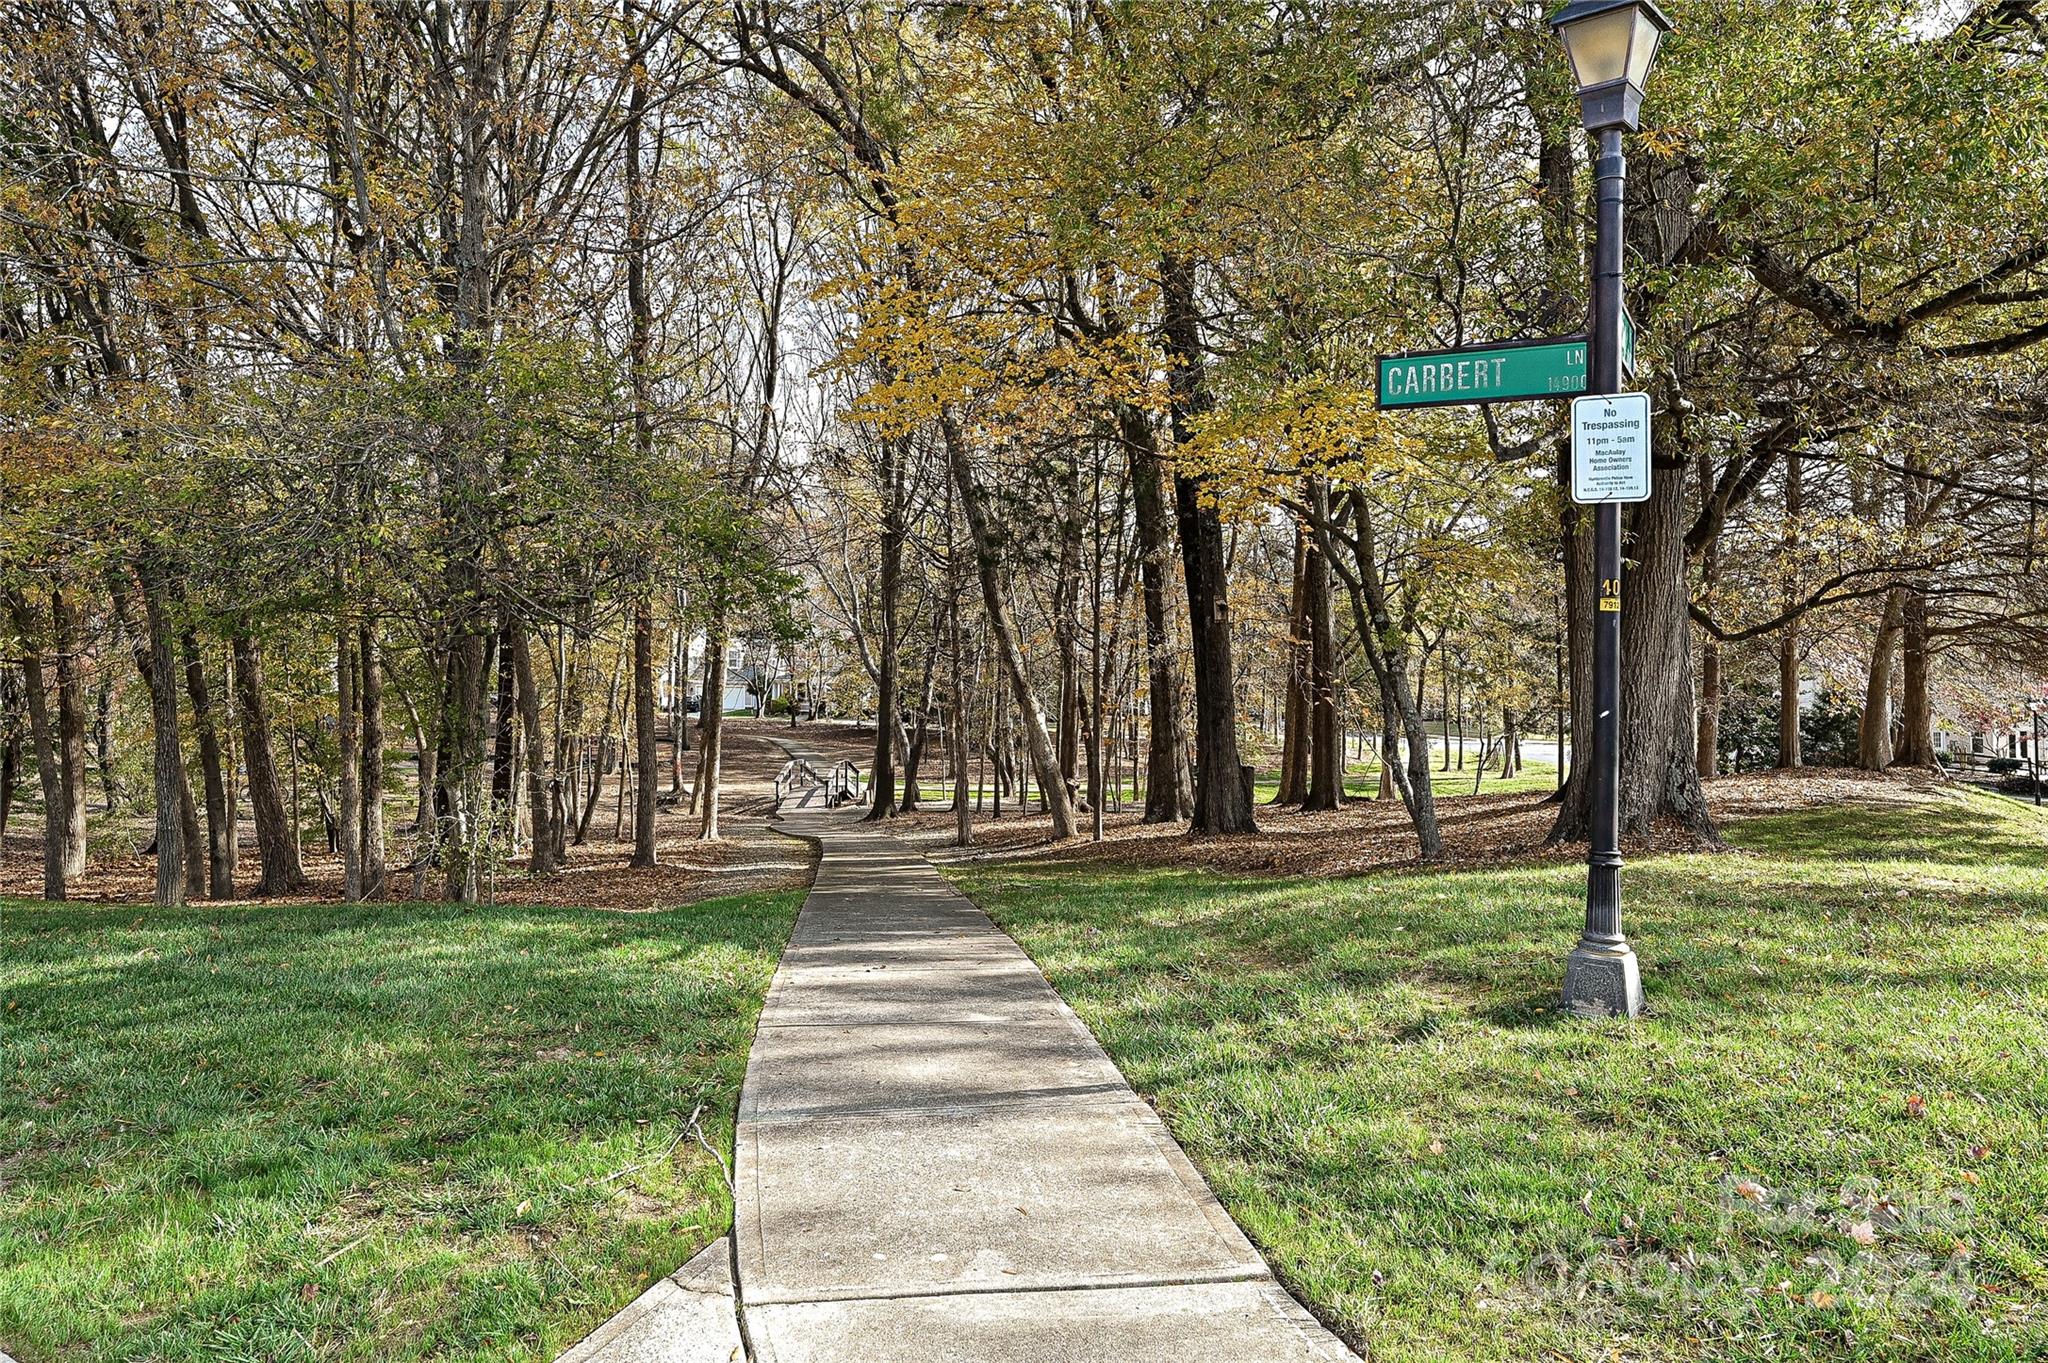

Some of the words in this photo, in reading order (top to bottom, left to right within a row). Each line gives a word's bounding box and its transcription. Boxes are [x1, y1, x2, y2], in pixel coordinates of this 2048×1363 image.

[1566, 349, 1584, 366] LN
[1388, 358, 1506, 396] CARBERT
[1603, 408, 1617, 417] No
[1582, 419, 1640, 431] Trespassing
[1587, 437, 1609, 446] 11pm
[1589, 457, 1607, 465] Home
[1608, 456, 1632, 464] Owners
[1593, 464, 1629, 472] Association
